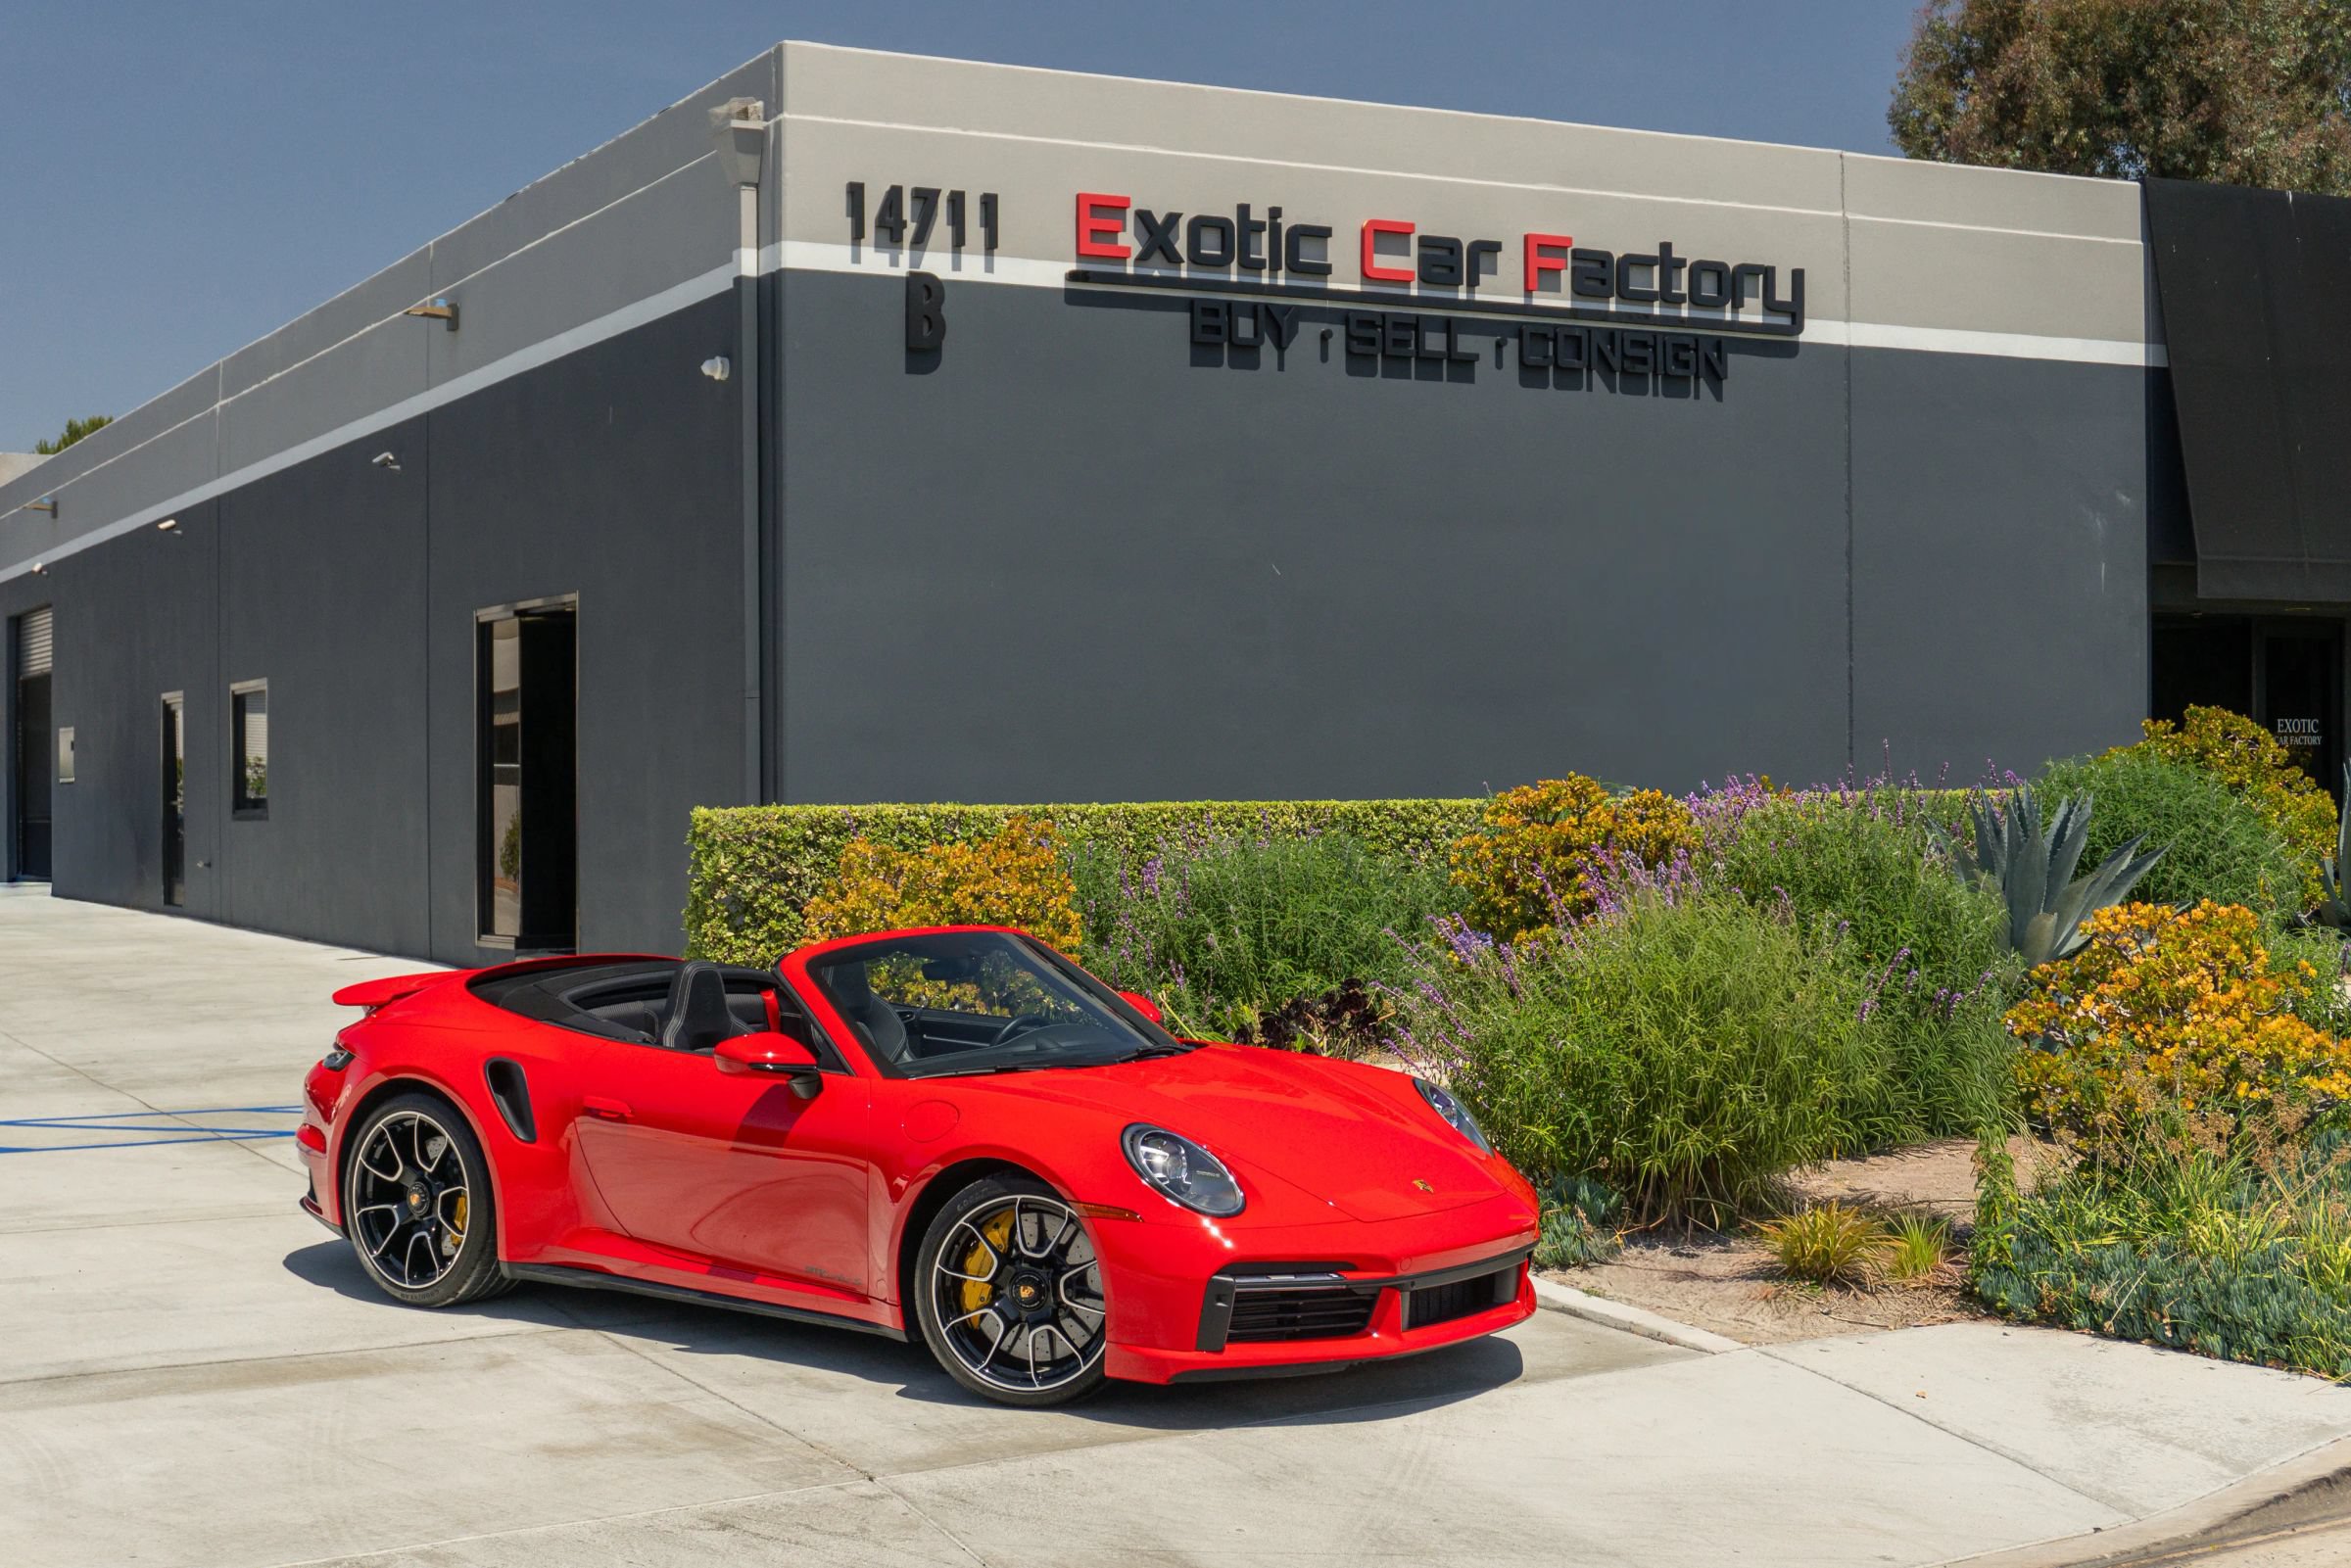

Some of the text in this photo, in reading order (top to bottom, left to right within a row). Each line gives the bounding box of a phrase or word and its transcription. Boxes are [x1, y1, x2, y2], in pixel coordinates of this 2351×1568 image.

[845, 181, 999, 251] 14711
[1076, 192, 1805, 337] Exotic Car Factory
[905, 270, 946, 351] B
[1191, 299, 1729, 381] BUY SELL CONSIGN
[2277, 718, 2320, 734] EXOTIC
[2289, 736, 2323, 745] FACTORY
